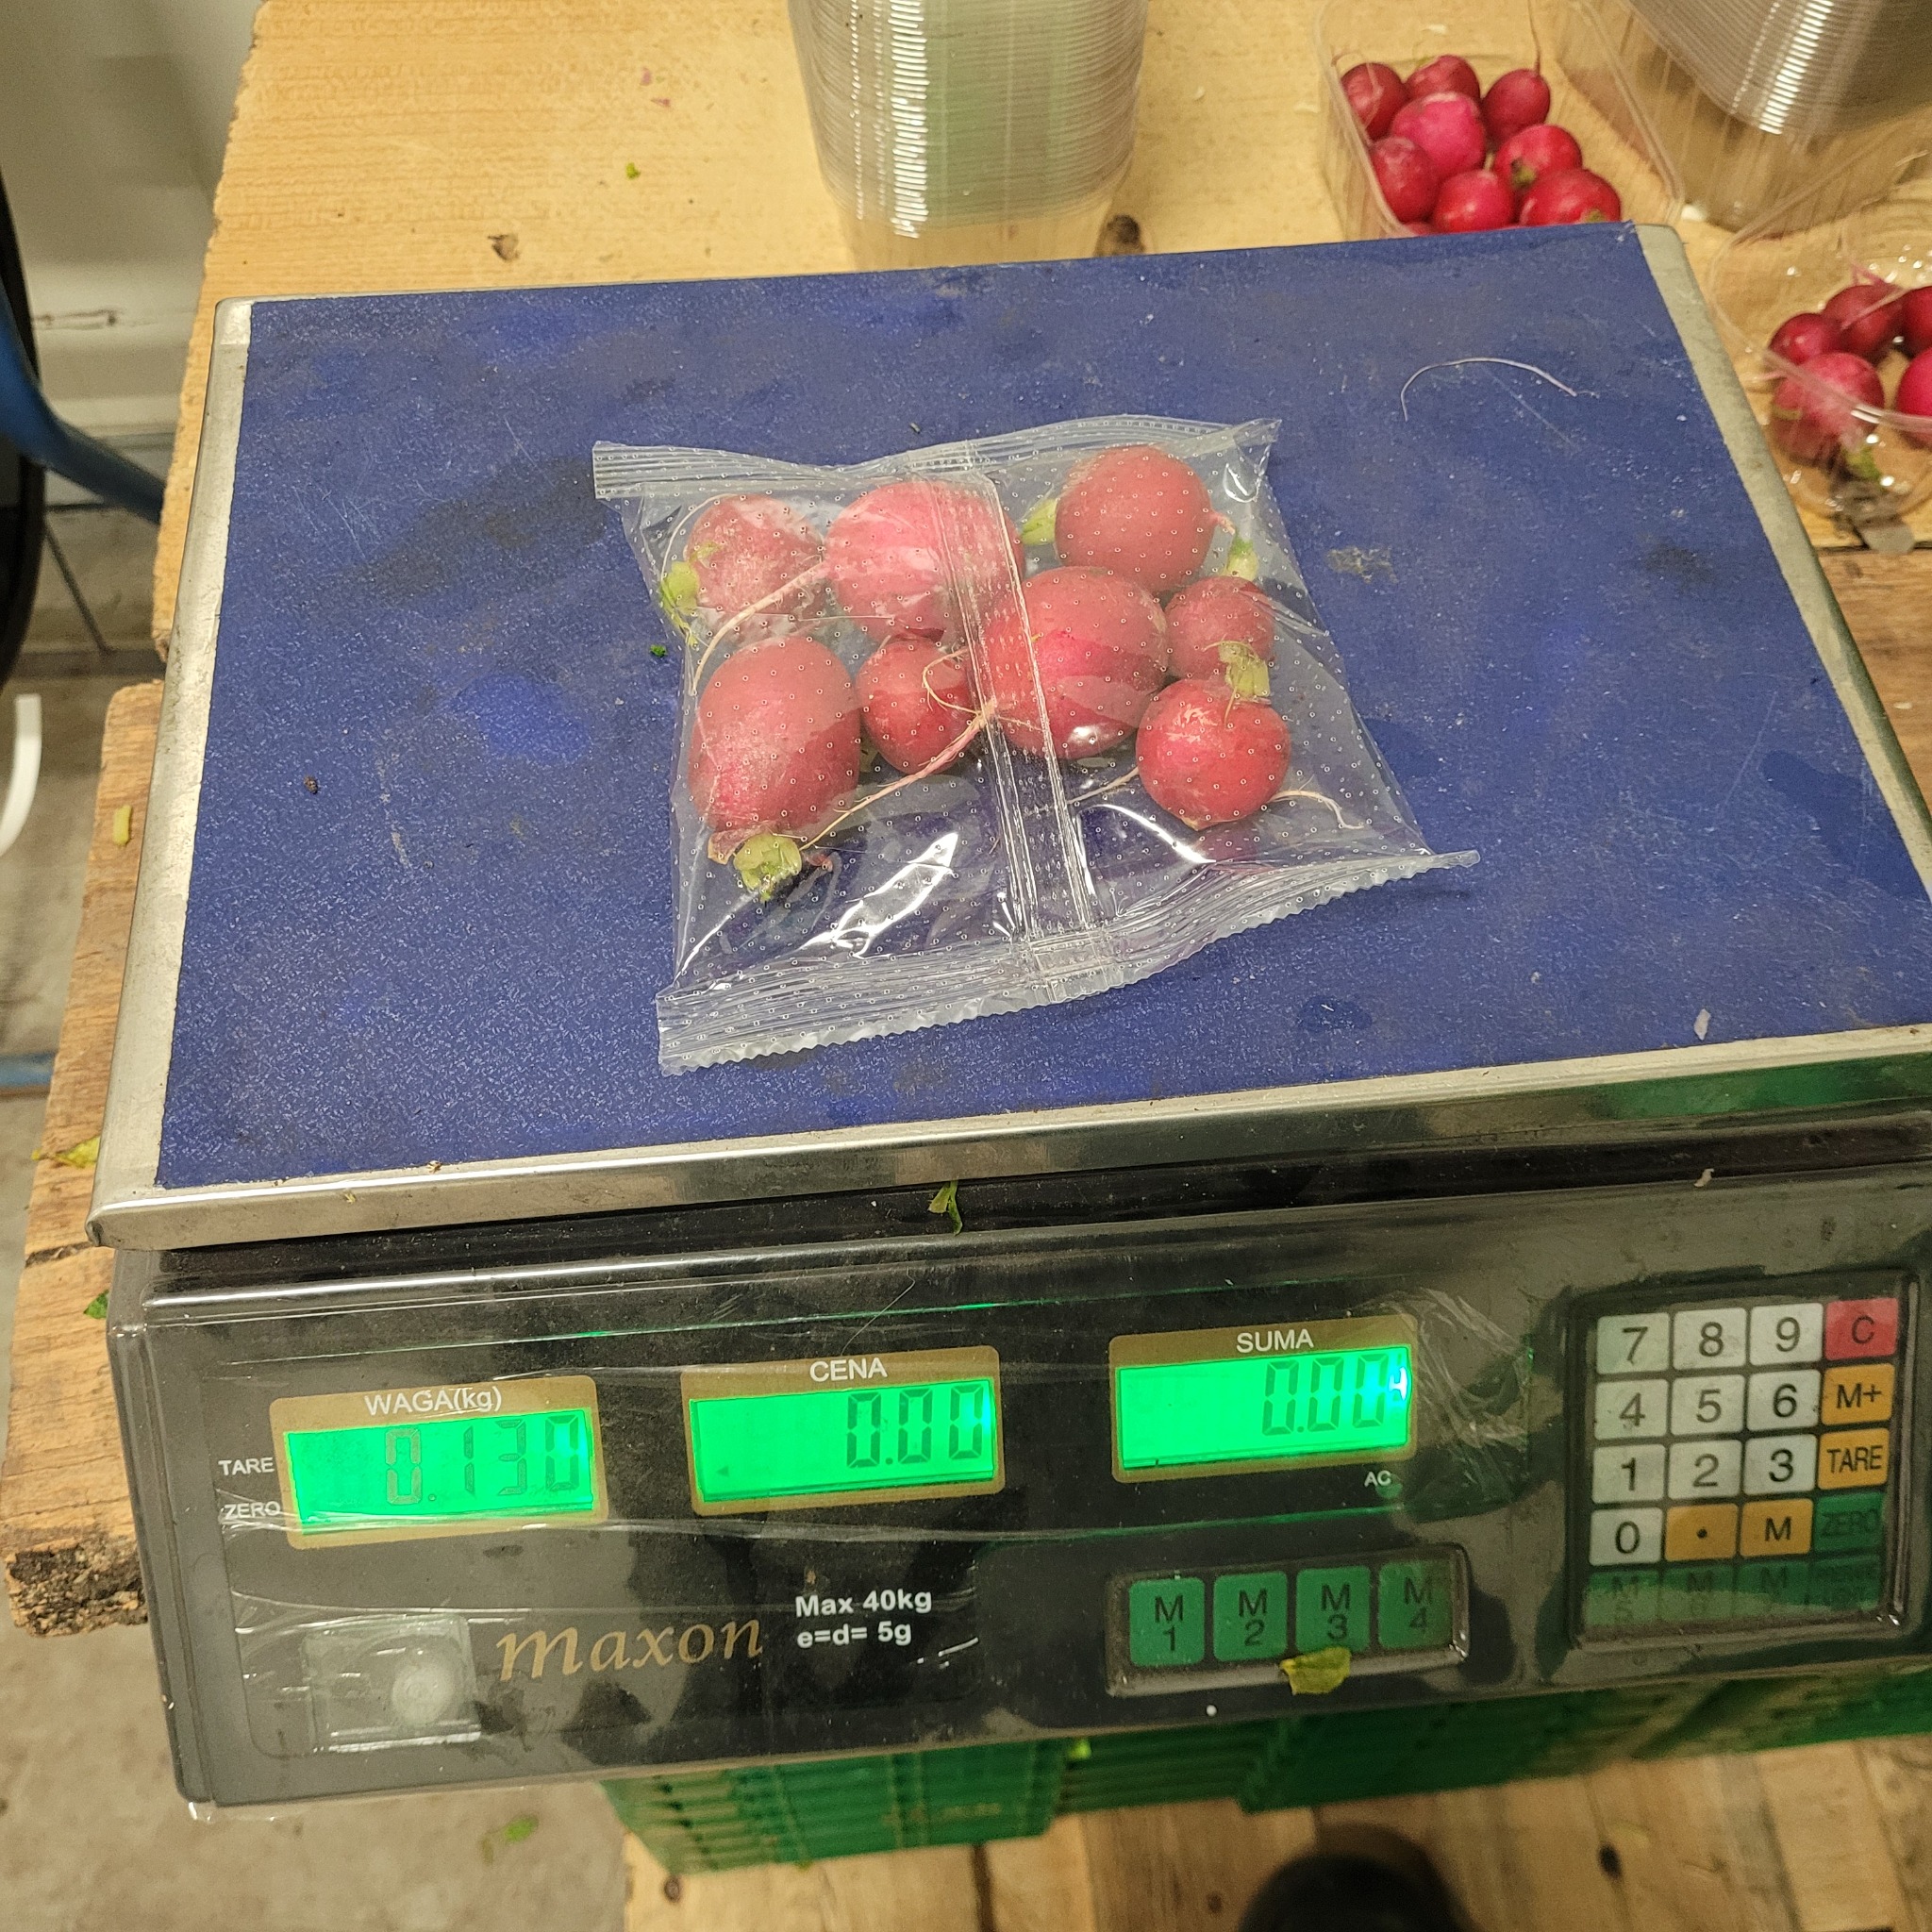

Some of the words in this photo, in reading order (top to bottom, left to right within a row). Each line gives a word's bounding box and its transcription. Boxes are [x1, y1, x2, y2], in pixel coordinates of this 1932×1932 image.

[1236, 1328, 1314, 1354] SUMA
[1622, 1326, 1649, 1365] 7
[1698, 1322, 1724, 1357] 8
[1775, 1317, 1801, 1352] 9
[1851, 1316, 1874, 1345] C
[809, 1357, 888, 1382] CENA
[364, 1386, 503, 1416] WAGA(kg)
[1262, 1354, 1390, 1437] 0.00
[1619, 1392, 1646, 1427] 4
[1695, 1389, 1722, 1423] 5
[1772, 1383, 1797, 1418] 6
[1836, 1383, 1882, 1409] M+
[847, 1384, 984, 1468] 0.00
[218, 1457, 275, 1476] TARE
[385, 1415, 580, 1506] 0.130
[1621, 1457, 1637, 1491] 1
[1693, 1454, 1720, 1487] 2
[1769, 1449, 1794, 1483] 3
[1826, 1445, 1883, 1474] TARE
[1364, 1470, 1391, 1487] AC
[224, 1500, 281, 1519] ZERO
[1615, 1521, 1641, 1555] 0
[1765, 1516, 1791, 1542] M
[1821, 1508, 1878, 1538] ZERO
[795, 1594, 854, 1618] Max
[862, 1589, 932, 1614] 40kg
[1238, 1588, 1268, 1619] M
[1322, 1583, 1351, 1612] M
[1404, 1576, 1433, 1606] M
[1155, 1594, 1183, 1624] M
[1409, 1607, 1428, 1633] 4
[878, 1620, 912, 1647] 5g
[1163, 1626, 1176, 1652] 1
[1243, 1619, 1264, 1647] 2
[1326, 1613, 1349, 1641] 3
[495, 1618, 764, 1682] maxon
